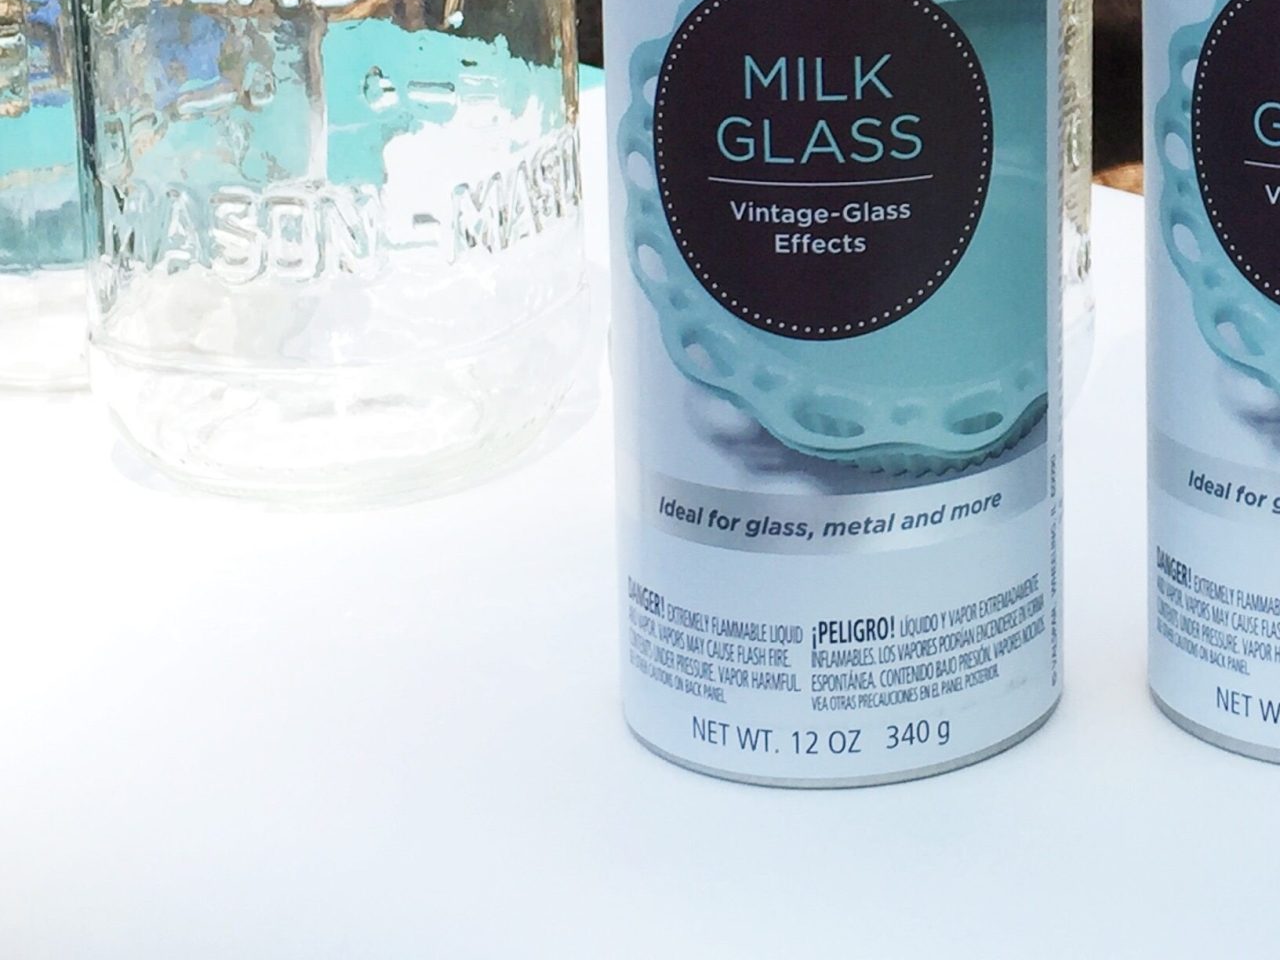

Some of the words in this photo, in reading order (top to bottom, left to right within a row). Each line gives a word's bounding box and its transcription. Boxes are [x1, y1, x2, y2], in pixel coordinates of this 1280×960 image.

[744, 54, 894, 102] MILK
[717, 114, 924, 164] GLASS
[730, 200, 911, 227] Vintage-Glass
[775, 234, 867, 254] Effects
[1188, 470, 1231, 501] Ideal
[1236, 486, 1267, 508] for
[659, 496, 702, 526] Ideal
[708, 512, 741, 532] for
[745, 517, 813, 540] glass,
[823, 515, 893, 538] metal
[901, 506, 946, 530] and
[951, 492, 1002, 522] more
[712, 616, 767, 643] FLAMMABLE
[770, 625, 802, 645] LIQUID
[812, 615, 894, 649] ¡PELIGRO!
[900, 613, 938, 637] LÍQUIDO
[940, 612, 947, 625] Y
[949, 603, 977, 625] VAPOR
[1212, 606, 1229, 626] MAY
[1231, 612, 1258, 636] CAUSE
[686, 634, 704, 655] MAY
[707, 640, 734, 662] CAUSE
[738, 645, 766, 666] FLASH
[769, 648, 791, 668] FIRE.
[879, 644, 896, 664] LOS
[899, 640, 937, 661] VAPORES
[1242, 638, 1272, 661] VAPOR
[718, 665, 749, 687] VAPOR
[752, 672, 801, 692] HARMFUL.
[880, 661, 934, 688] CONTENIDO
[936, 656, 957, 678] BAJO
[812, 695, 828, 711] VEA
[831, 695, 856, 710] OTRAS
[858, 687, 918, 709] PRECAUCIONES
[1216, 686, 1252, 717] NET
[692, 716, 730, 744] NET
[736, 728, 779, 753] WT.
[791, 731, 819, 754] 12
[828, 730, 861, 754] OZ
[886, 719, 930, 749] 340
[937, 720, 951, 745] g
